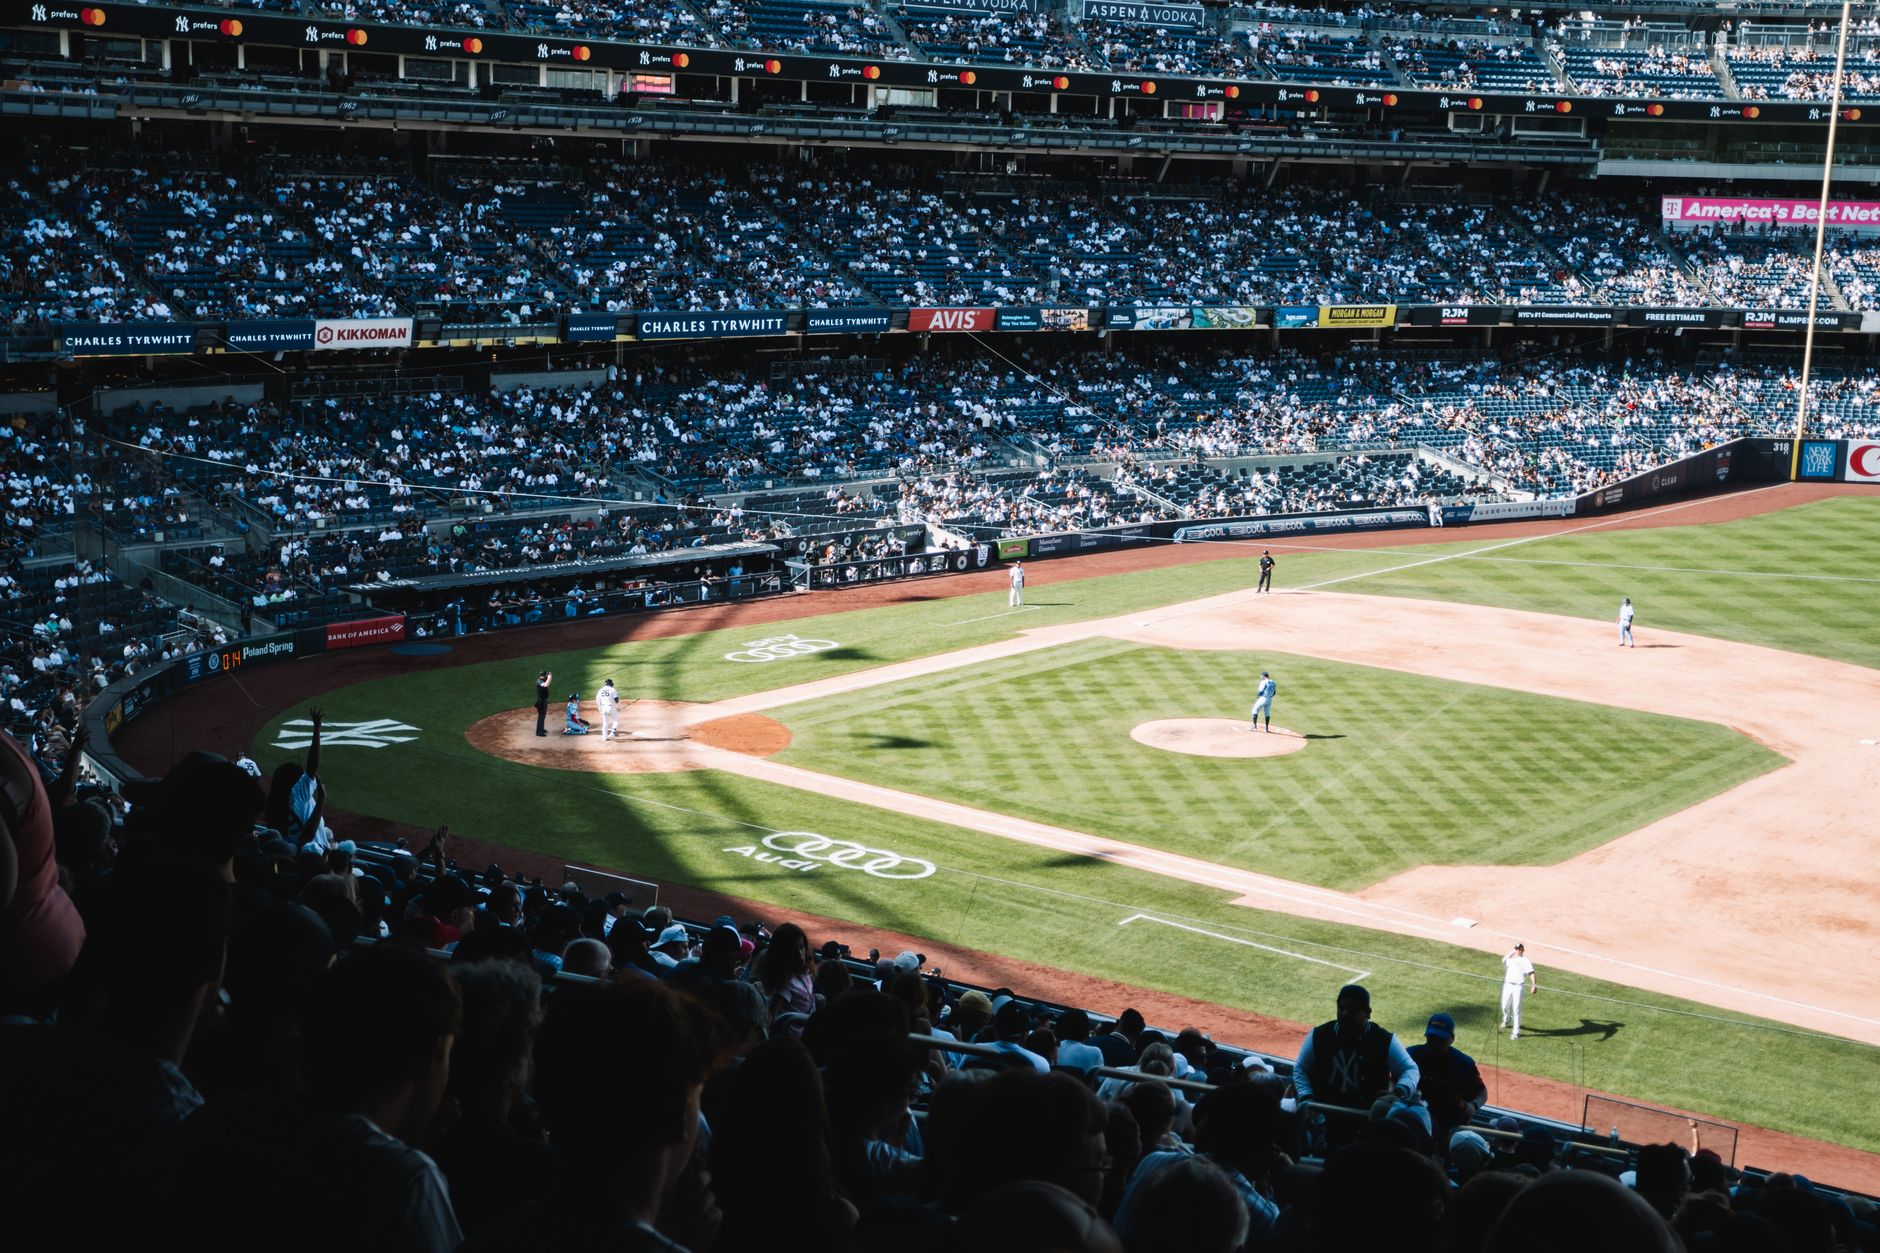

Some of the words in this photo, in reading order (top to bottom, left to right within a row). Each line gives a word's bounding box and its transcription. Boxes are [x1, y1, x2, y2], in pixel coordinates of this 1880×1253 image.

[51, 10, 78, 19] prefers
[1091, 4, 1136, 18] ASPEN
[1153, 9, 1197, 22] VODKA
[193, 22, 218, 30] prefers
[1668, 202, 1678, 214] T
[1686, 203, 1788, 220] America's
[1332, 308, 1355, 318] MORGAN
[1356, 308, 1360, 318] &
[1361, 308, 1384, 317] MORGAN
[1442, 308, 1468, 317] RJM
[1745, 312, 1776, 322] RJM
[846, 318, 888, 326] TYRWHITT
[928, 311, 976, 329] AVIS
[1666, 314, 1705, 322] ESTIMATE
[642, 320, 705, 332] CHARLES
[712, 318, 784, 331] TYRWHITT
[337, 328, 407, 340] KIKKOMAN
[66, 337, 122, 346] CHARLES
[127, 336, 192, 344] TYRWHITT
[1808, 447, 1830, 456] NEW
[1806, 455, 1832, 464] YORK
[1807, 464, 1828, 472] LIFE
[1332, 518, 1350, 526] COOL
[1370, 514, 1389, 522] COOL
[1246, 526, 1266, 534] COOL
[1286, 522, 1306, 530] COOL
[1204, 528, 1226, 538] COOL
[358, 628, 389, 637] AMERICA
[243, 644, 268, 660] Poland
[269, 642, 294, 654] Spring
[722, 845, 822, 872] Audi
[1328, 1048, 1360, 1092] NY
